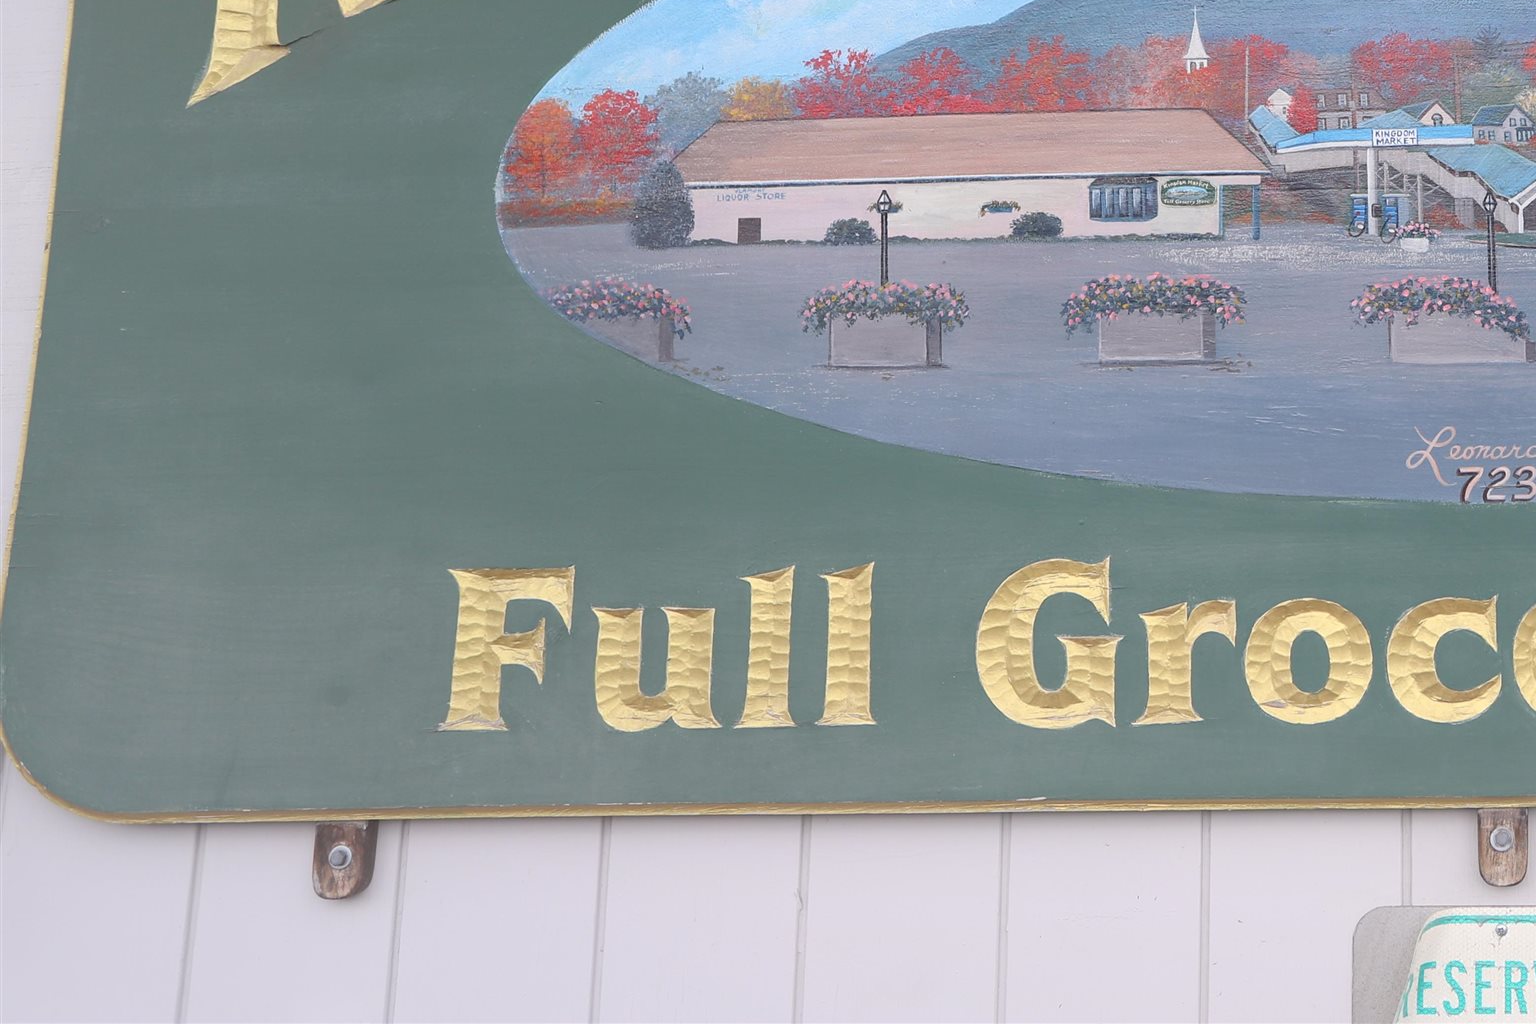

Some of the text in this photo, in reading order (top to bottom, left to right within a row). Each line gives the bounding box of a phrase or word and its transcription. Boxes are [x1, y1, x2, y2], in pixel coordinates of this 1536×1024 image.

[1375, 129, 1416, 138] KINGDOM
[1376, 137, 1417, 145] MARKET
[716, 192, 786, 202] LIQUOR STORE
[446, 564, 876, 733] Full
